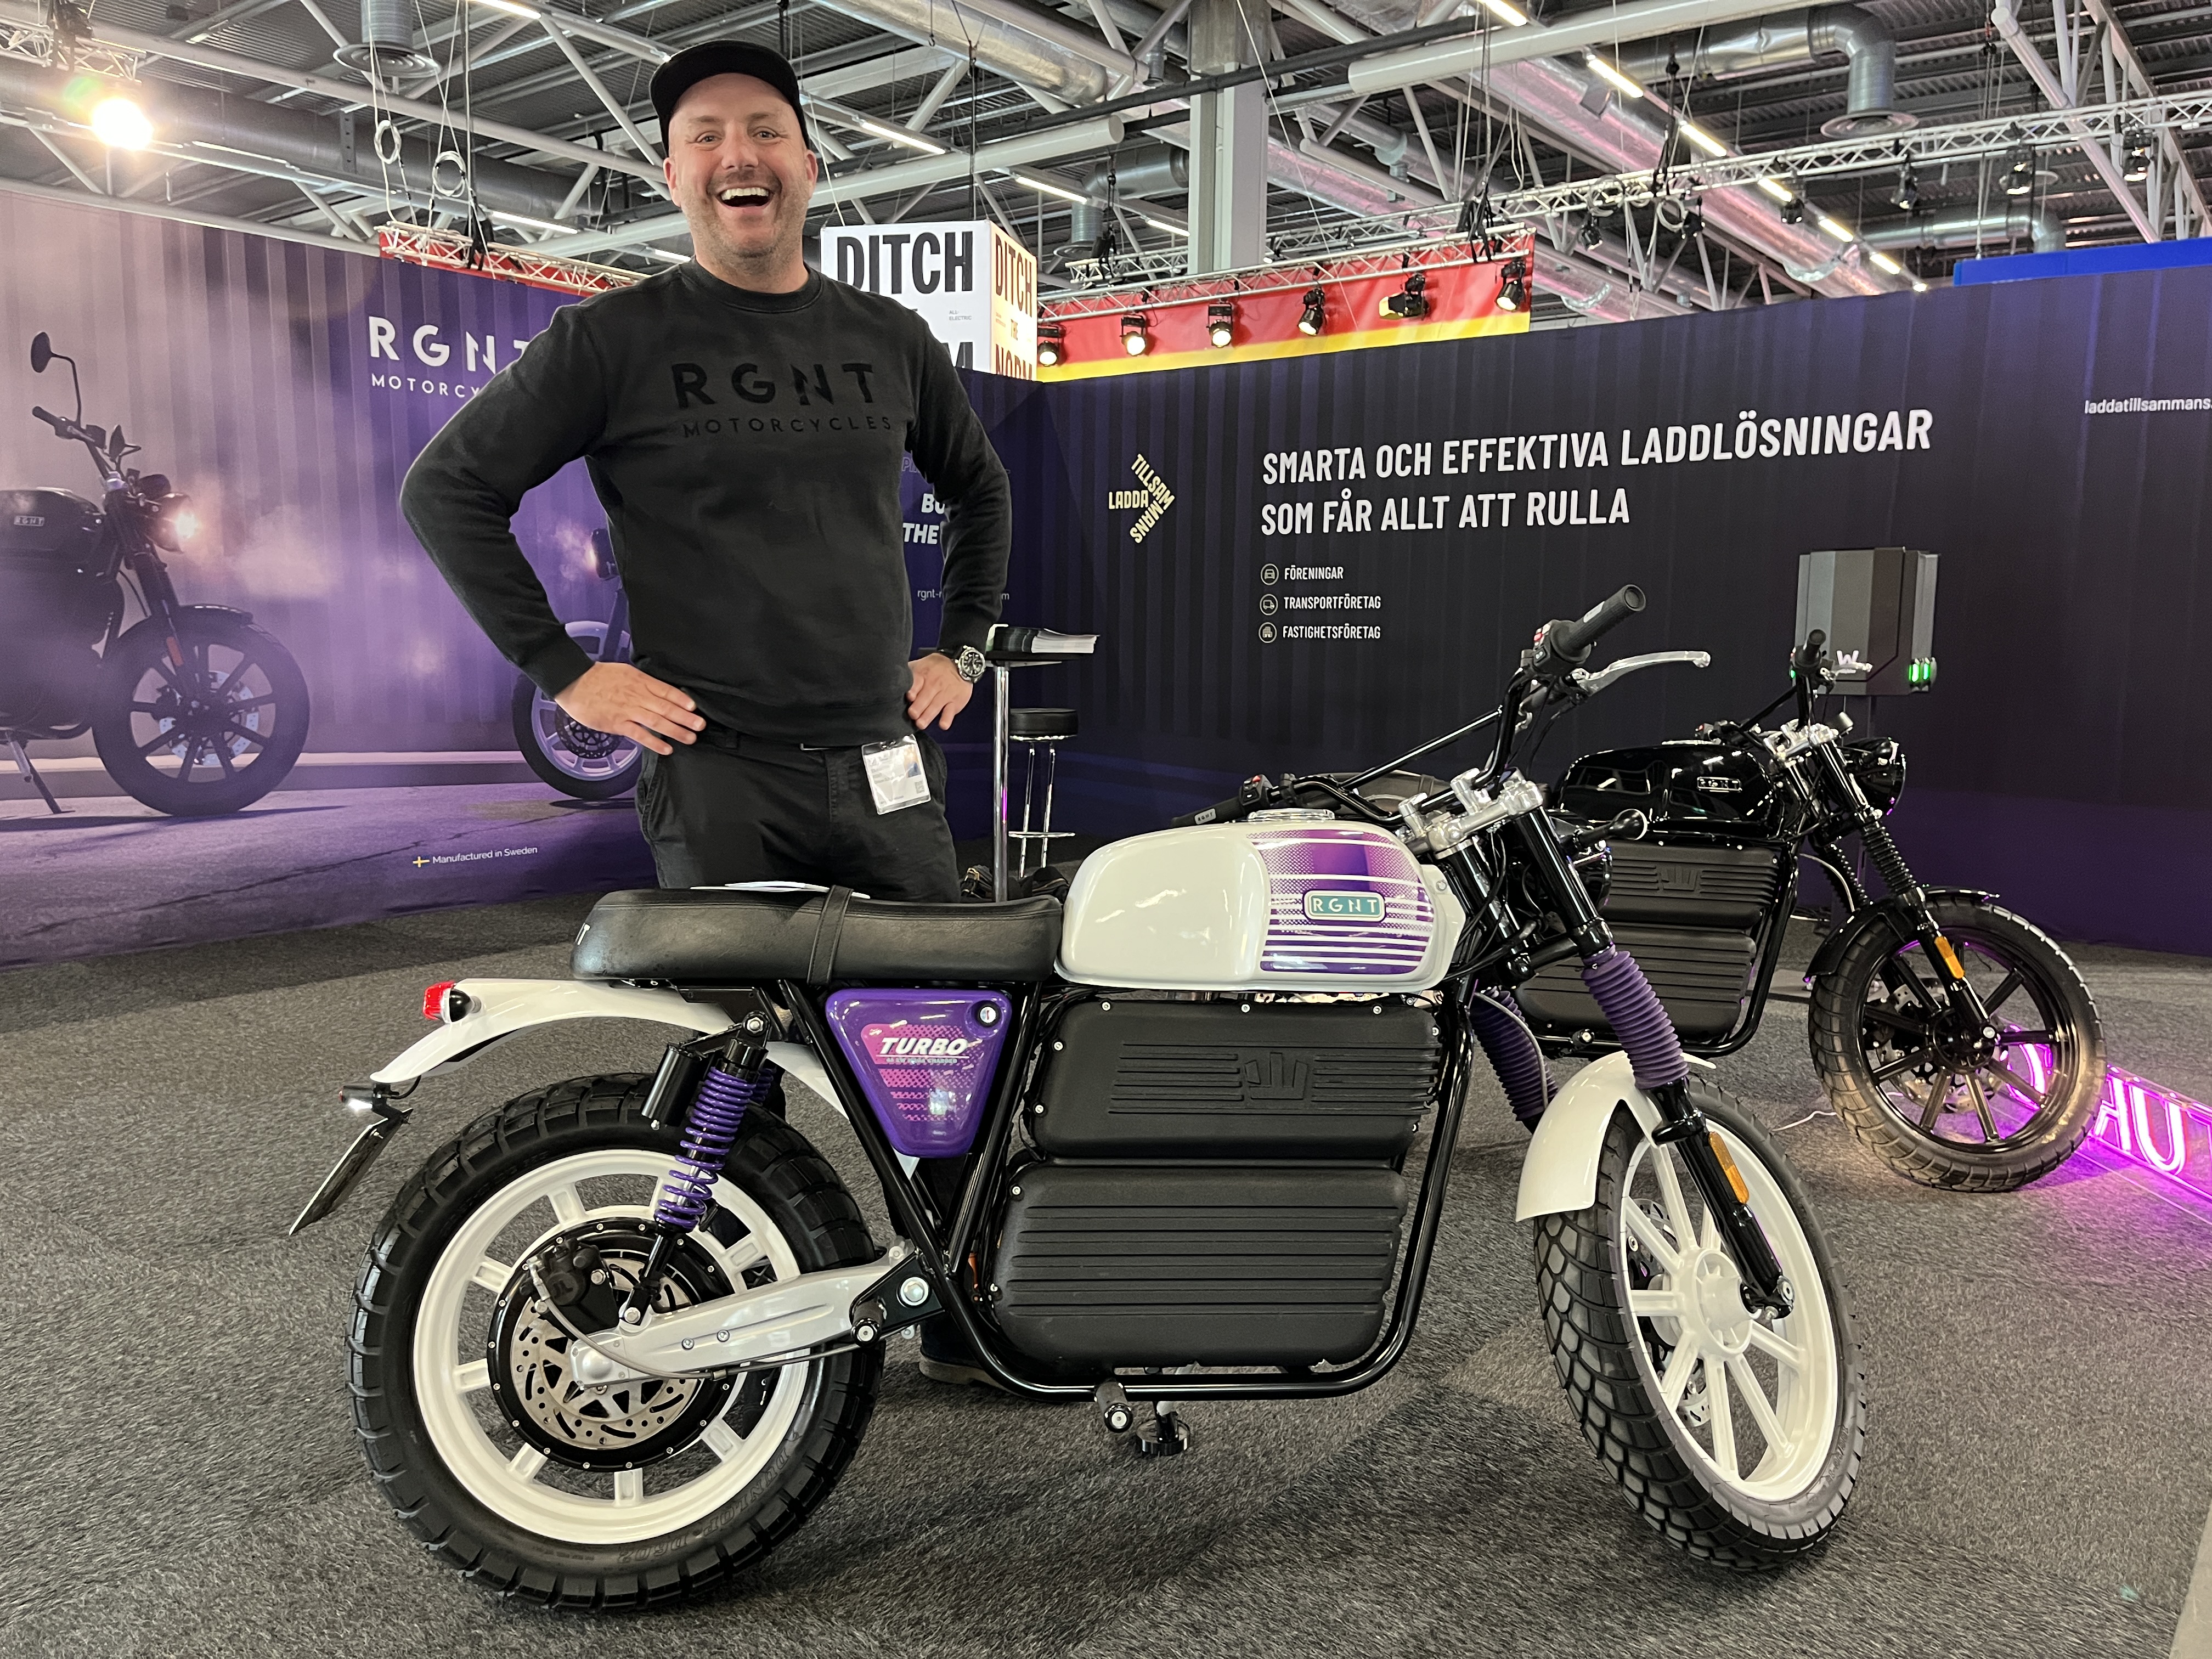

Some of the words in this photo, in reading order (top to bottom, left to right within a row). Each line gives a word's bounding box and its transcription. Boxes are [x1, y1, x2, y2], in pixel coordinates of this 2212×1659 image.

[837, 231, 973, 294] DITCH
[995, 233, 1032, 318] DITCH
[671, 362, 874, 409] RGNT
[682, 416, 891, 438] MOTORCYCLES
[1262, 447, 1366, 485] SMARTA
[1376, 442, 1432, 478] OCH
[1442, 431, 1609, 475] EFFEKTIVA
[1620, 409, 1934, 466] LADDLÖSNINGAR
[1131, 453, 1175, 511] TILLSAM
[1108, 490, 1149, 510] LADDA
[1261, 501, 1313, 535] SOM
[1323, 487, 1373, 533] FÅR
[1380, 495, 1451, 531] ALLT
[1458, 492, 1516, 529] ATT
[1526, 488, 1630, 527] RULLA
[902, 522, 939, 545] THE
[1284, 565, 1344, 580] FÖRENINGAR
[1283, 593, 1381, 610] TRANSPORTFÖRETAG
[1283, 623, 1381, 639] FASTIGHETSFÖRETAG
[432, 850, 493, 864] Manufactured
[495, 849, 503, 857] in
[504, 846, 538, 857] Sweden
[1312, 898, 1378, 913] RGNT
[879, 1037, 968, 1056] TURBO
[703, 1448, 789, 1536] DUNLOP
